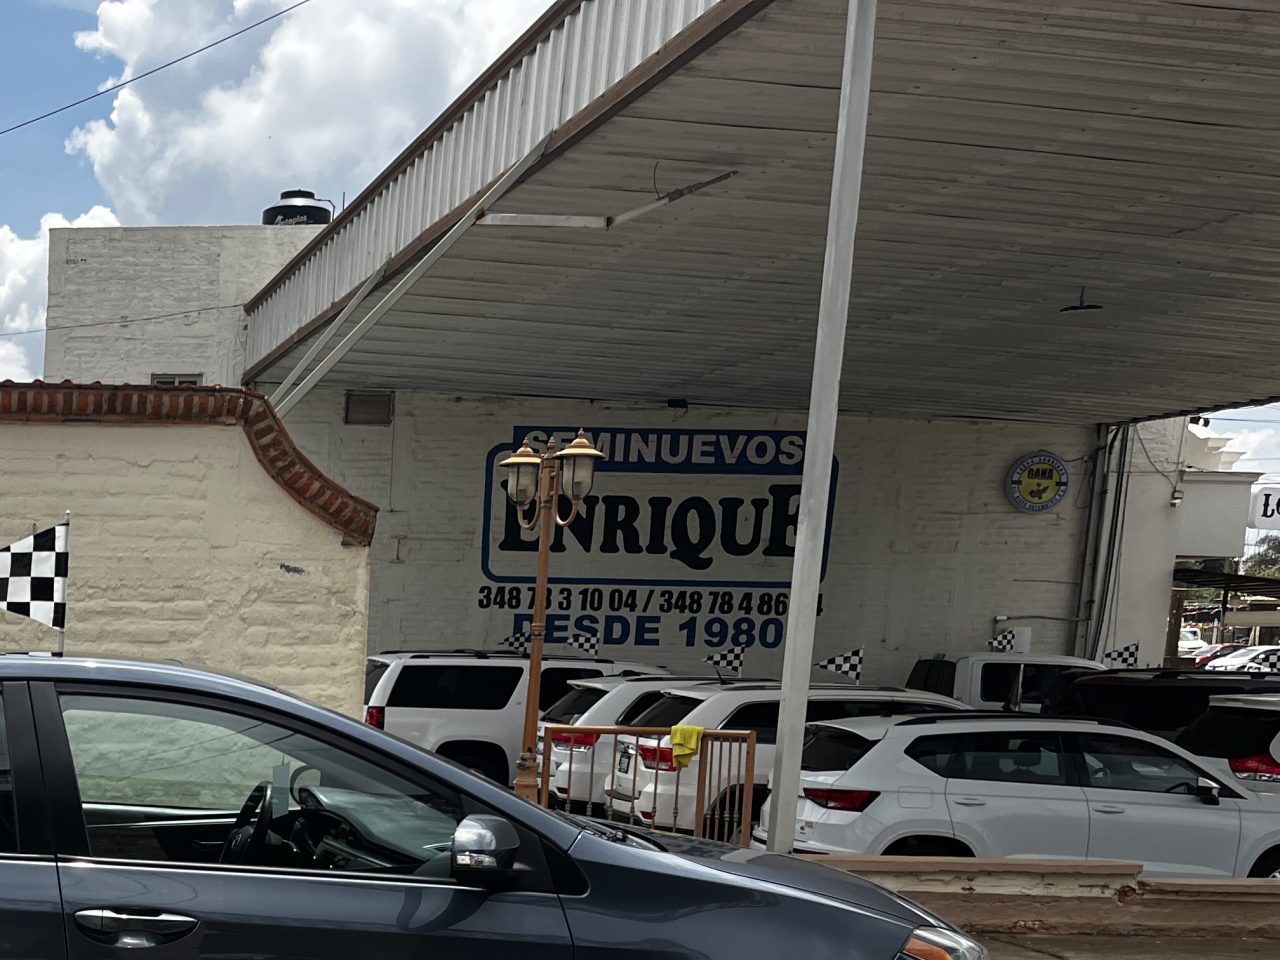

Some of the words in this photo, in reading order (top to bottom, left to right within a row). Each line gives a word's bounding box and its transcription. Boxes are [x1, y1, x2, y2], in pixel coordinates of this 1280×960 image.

[1028, 468, 1054, 480] GANA
[478, 585, 522, 609] 348
[558, 588, 572, 611] 3
[578, 588, 604, 612] 10
[609, 589, 638, 613] 04
[642, 589, 655, 613] /
[659, 590, 703, 614] 348
[708, 591, 734, 615] 78
[738, 592, 754, 615] 4
[757, 592, 789, 616] 86
[679, 616, 784, 649] 1980
